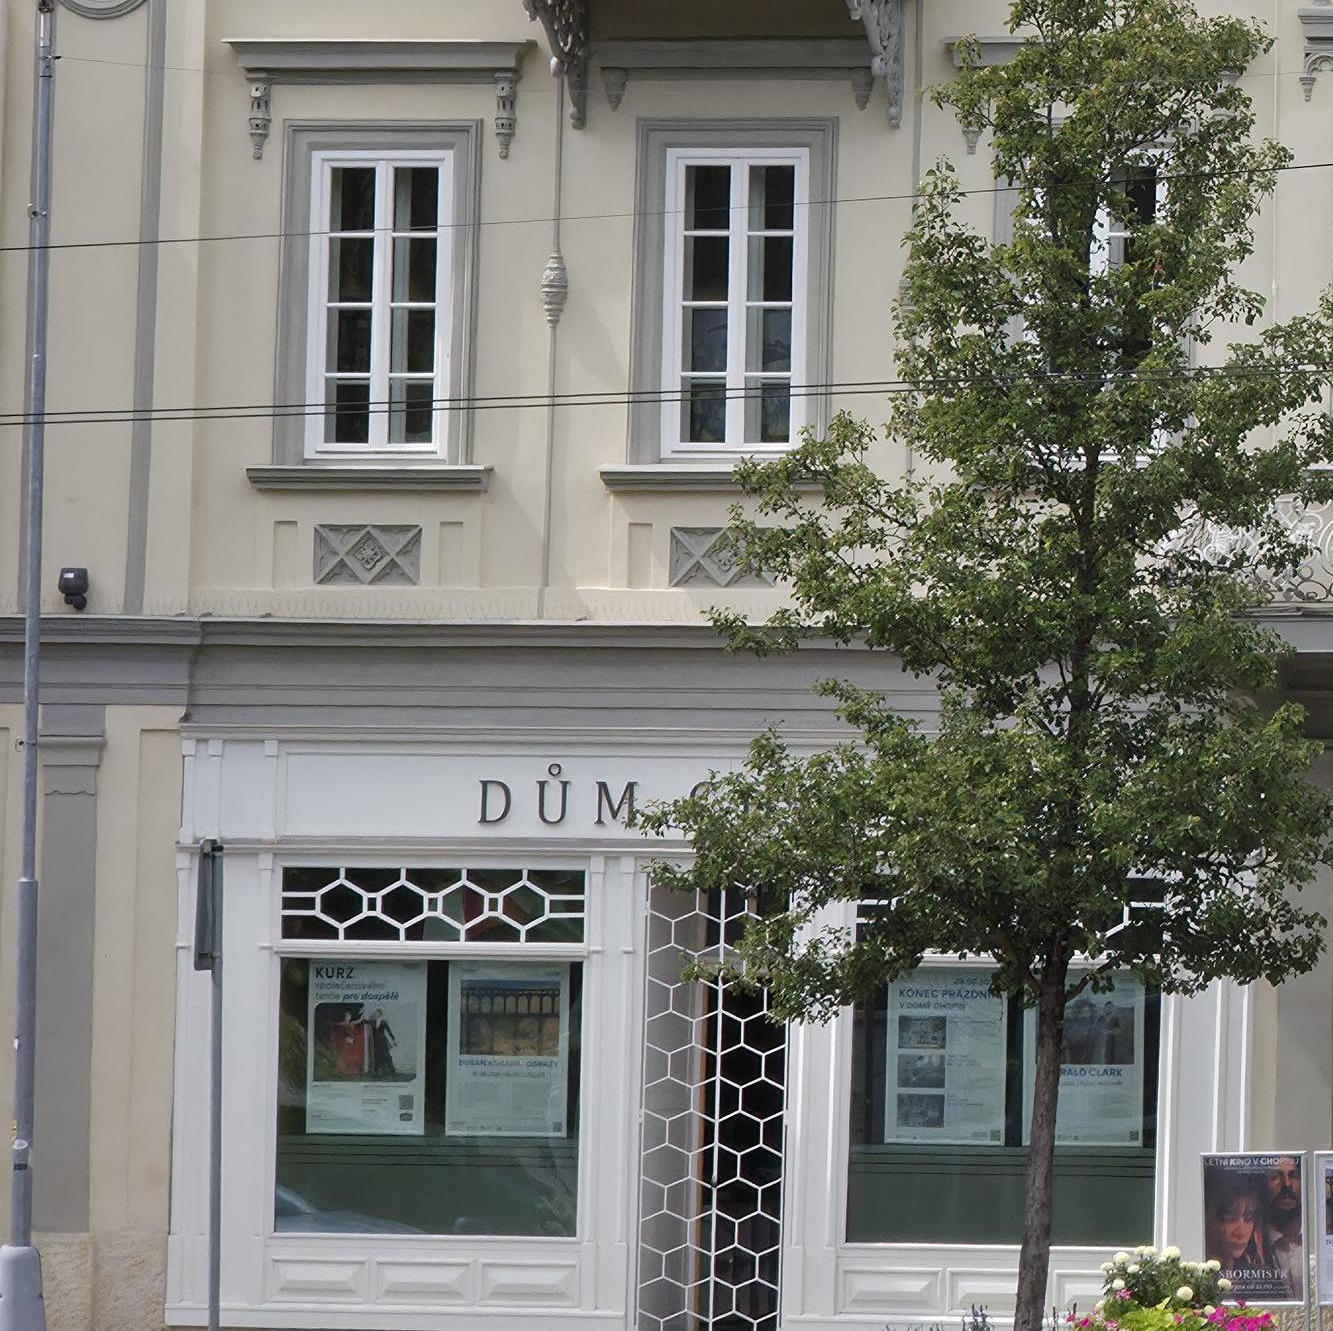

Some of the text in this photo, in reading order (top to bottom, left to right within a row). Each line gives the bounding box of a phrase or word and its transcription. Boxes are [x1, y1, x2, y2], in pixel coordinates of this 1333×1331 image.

[478, 763, 638, 825] DŮM
[315, 966, 354, 979] KURZ
[898, 988, 938, 998] KONEC
[1088, 1067, 1123, 1077] CLARK
[1229, 1157, 1251, 1166] KINO
